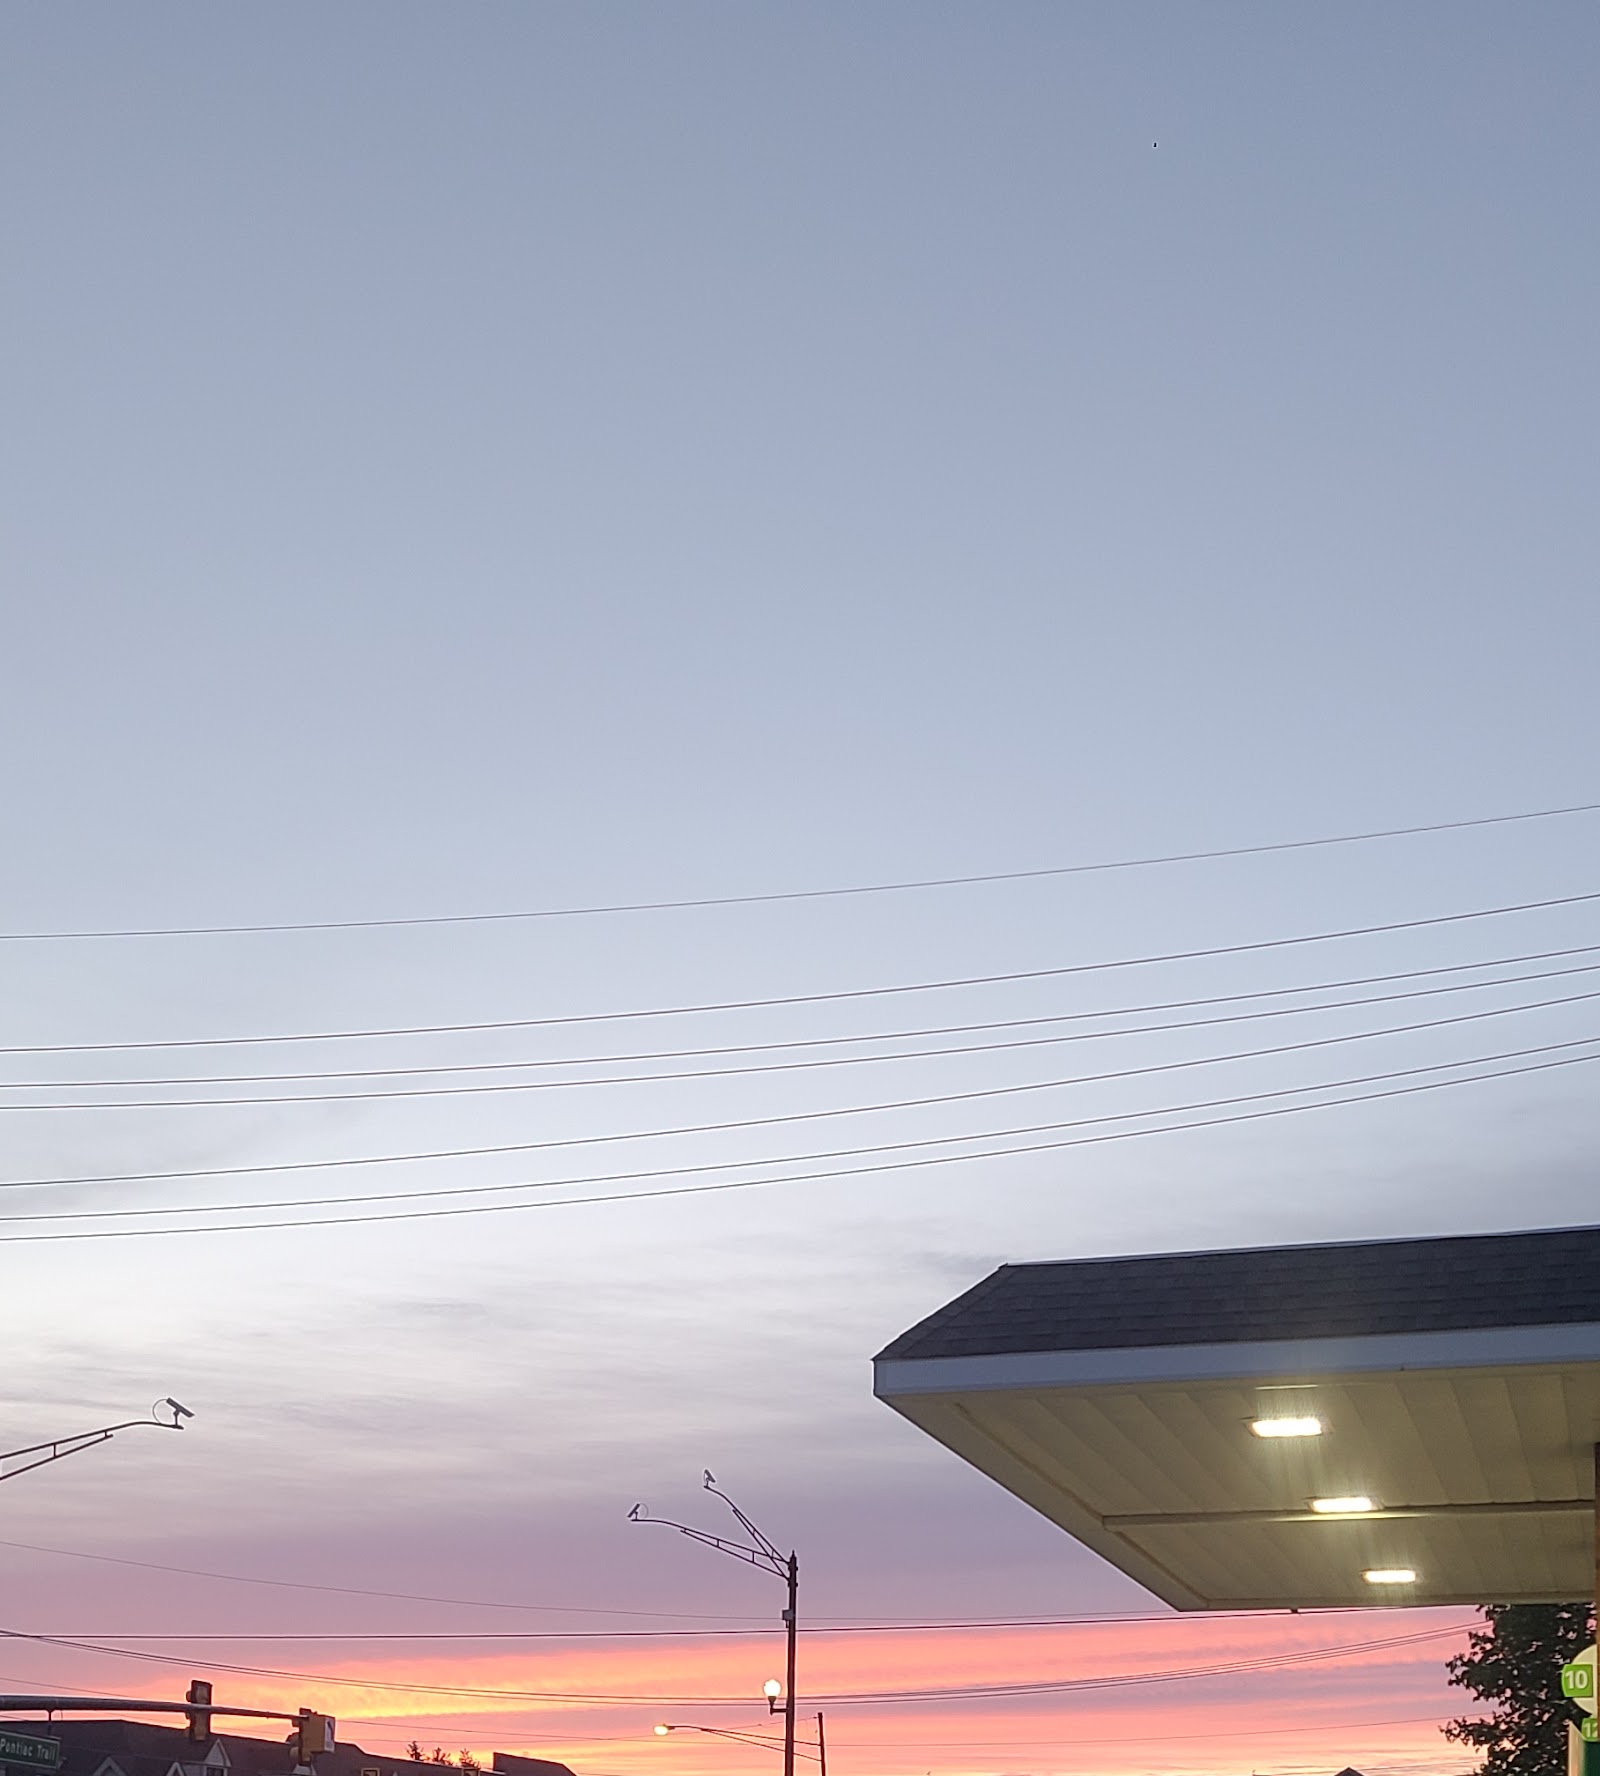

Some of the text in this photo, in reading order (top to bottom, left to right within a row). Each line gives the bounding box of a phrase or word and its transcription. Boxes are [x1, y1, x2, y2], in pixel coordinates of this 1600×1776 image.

[1565, 1670, 1588, 1690] 10
[0, 1738, 57, 1761] Pontiac Trail
